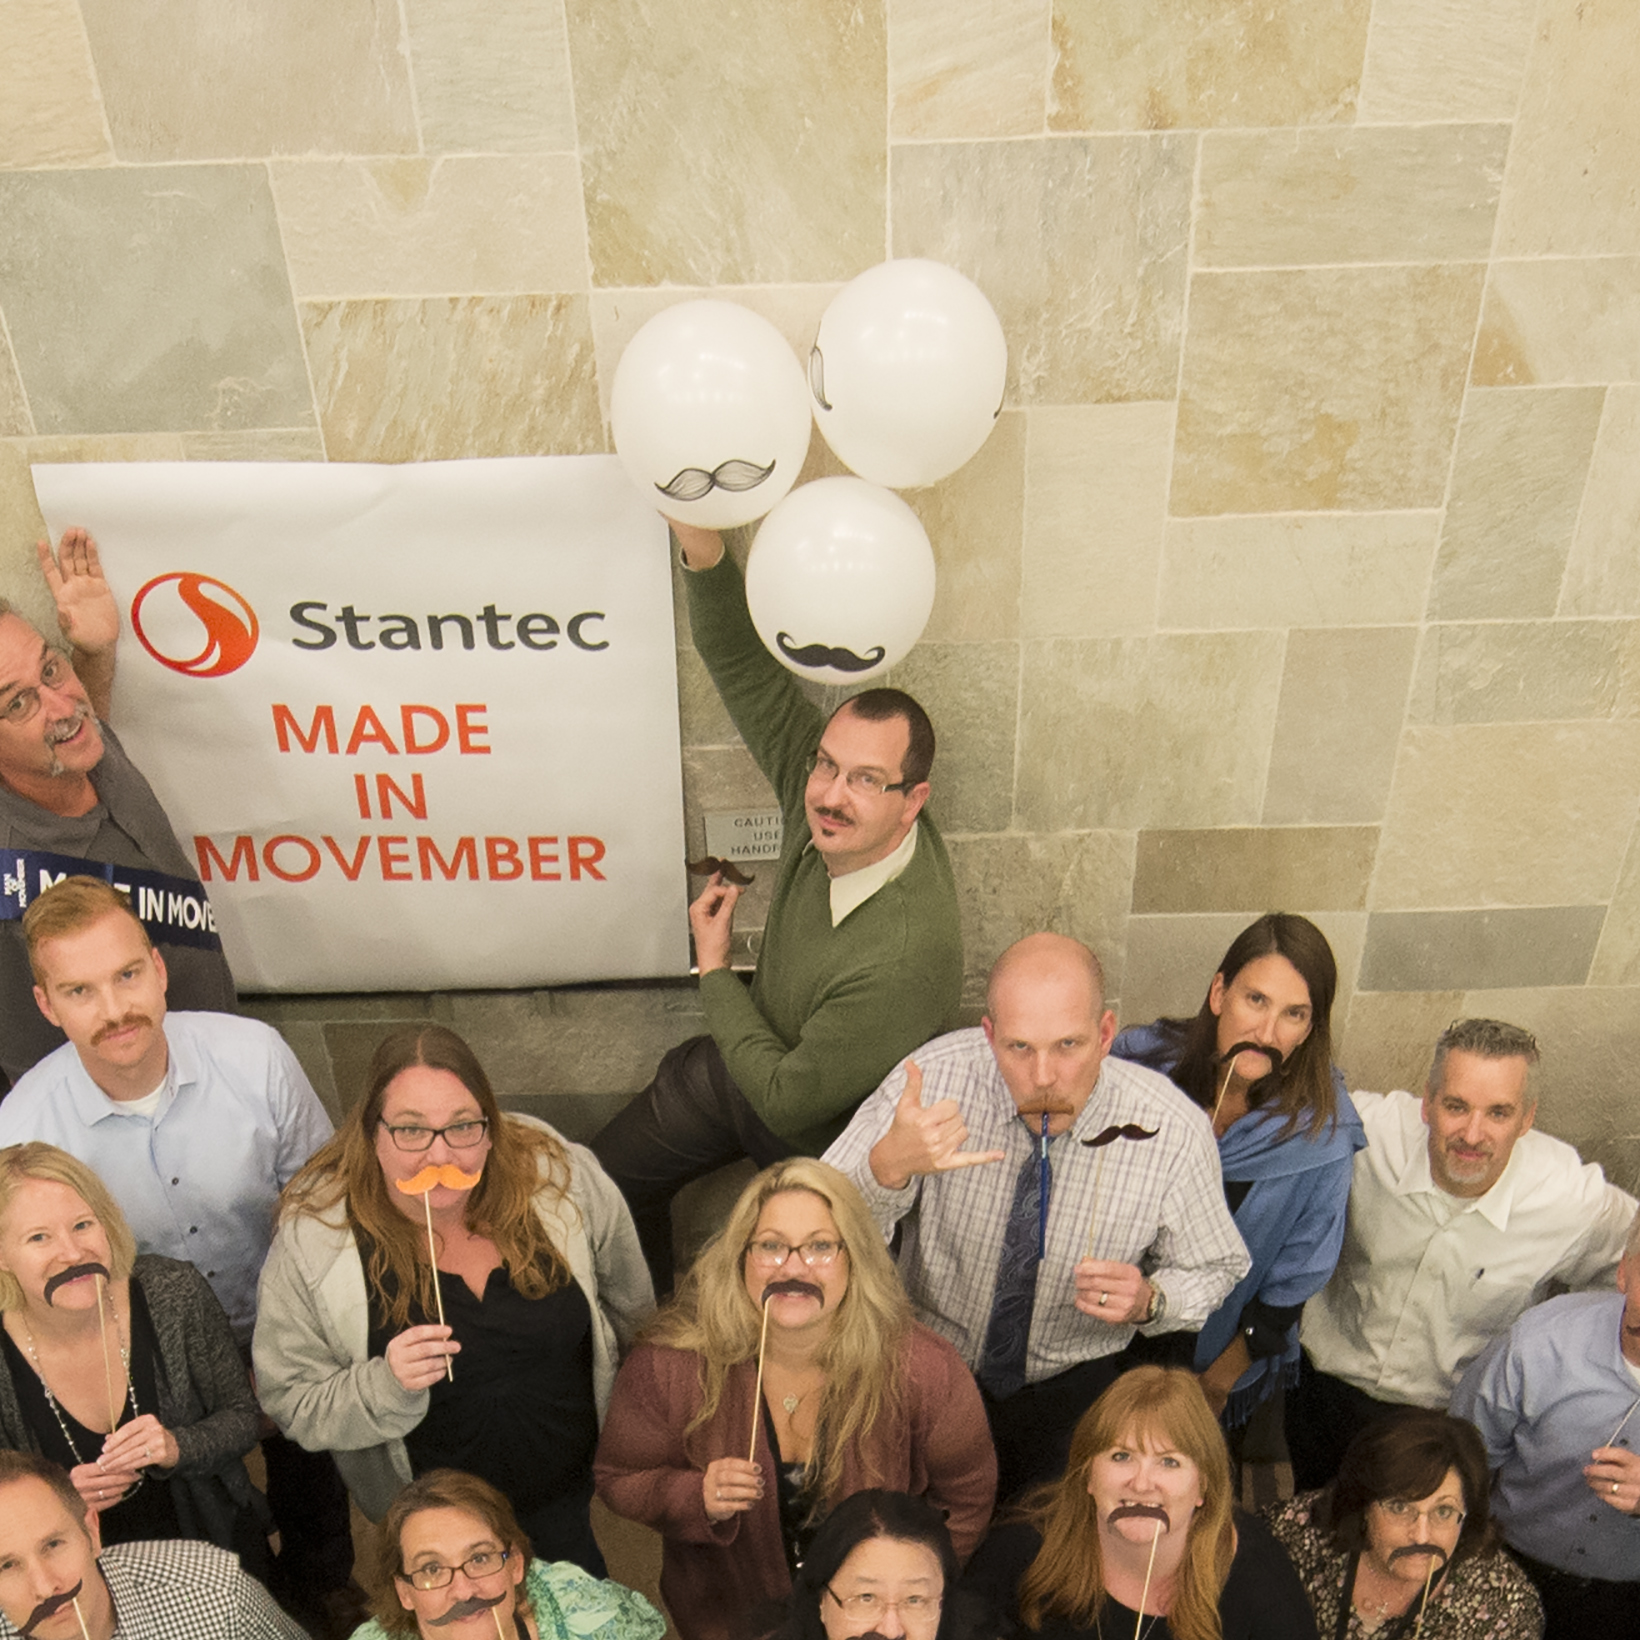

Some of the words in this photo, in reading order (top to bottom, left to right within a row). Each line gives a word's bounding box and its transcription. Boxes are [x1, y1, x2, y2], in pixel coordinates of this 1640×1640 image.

[288, 600, 611, 653] Stantec
[270, 703, 493, 756] MADE
[353, 772, 429, 821] IN
[734, 816, 784, 828] CAUTI
[193, 833, 608, 884] MOVEMBER
[138, 886, 164, 922] IN
